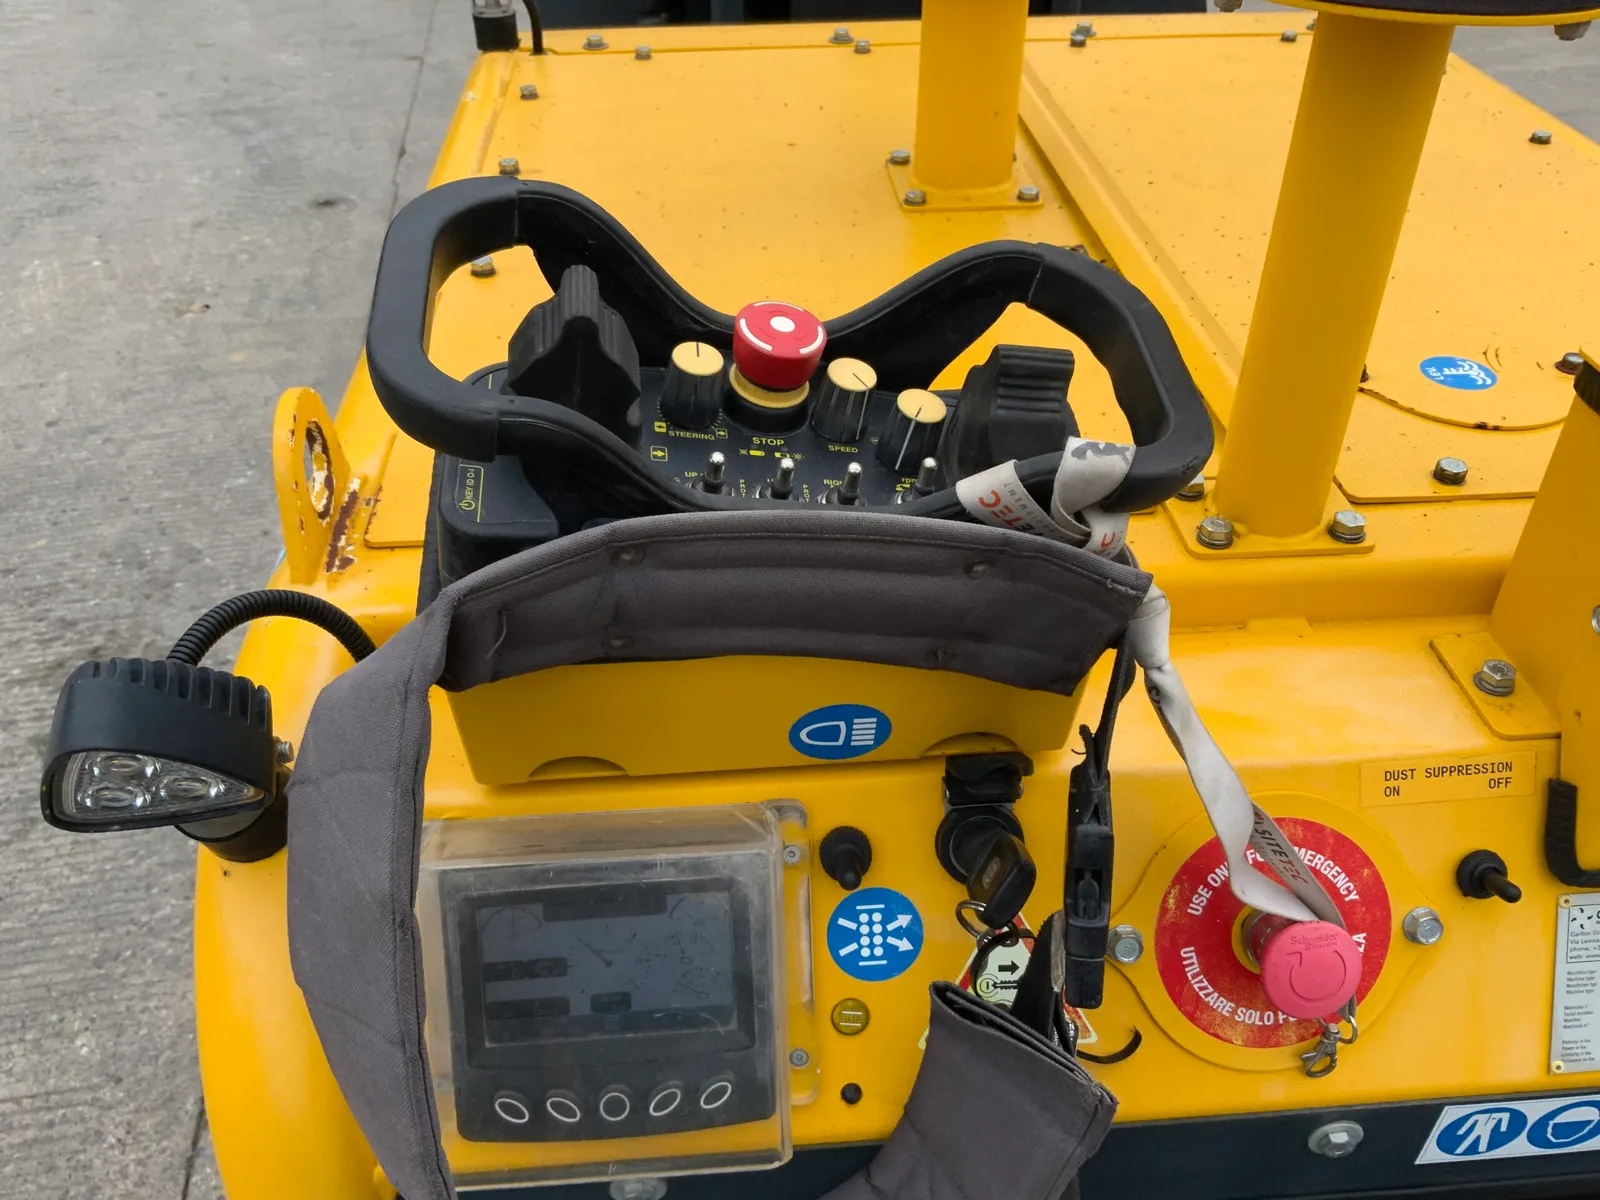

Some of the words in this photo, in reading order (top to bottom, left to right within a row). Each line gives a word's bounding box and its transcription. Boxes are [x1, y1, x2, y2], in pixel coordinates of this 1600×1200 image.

[668, 430, 715, 441] STEERING
[752, 436, 785, 447] STOP
[828, 445, 859, 453] SPEED
[465, 486, 474, 500] KEY
[1384, 768, 1416, 782] DUST
[1424, 761, 1513, 779] SUPPRESSION
[1384, 785, 1400, 797] ON
[1488, 776, 1513, 789] OFF
[1253, 827, 1309, 884] SITETEC
[1187, 885, 1213, 916] USE
[1207, 862, 1229, 888] ON
[1293, 846, 1360, 902] MERGENCY
[1180, 946, 1236, 1017] UTILIZZARE
[1234, 1007, 1274, 1026] SOLO
